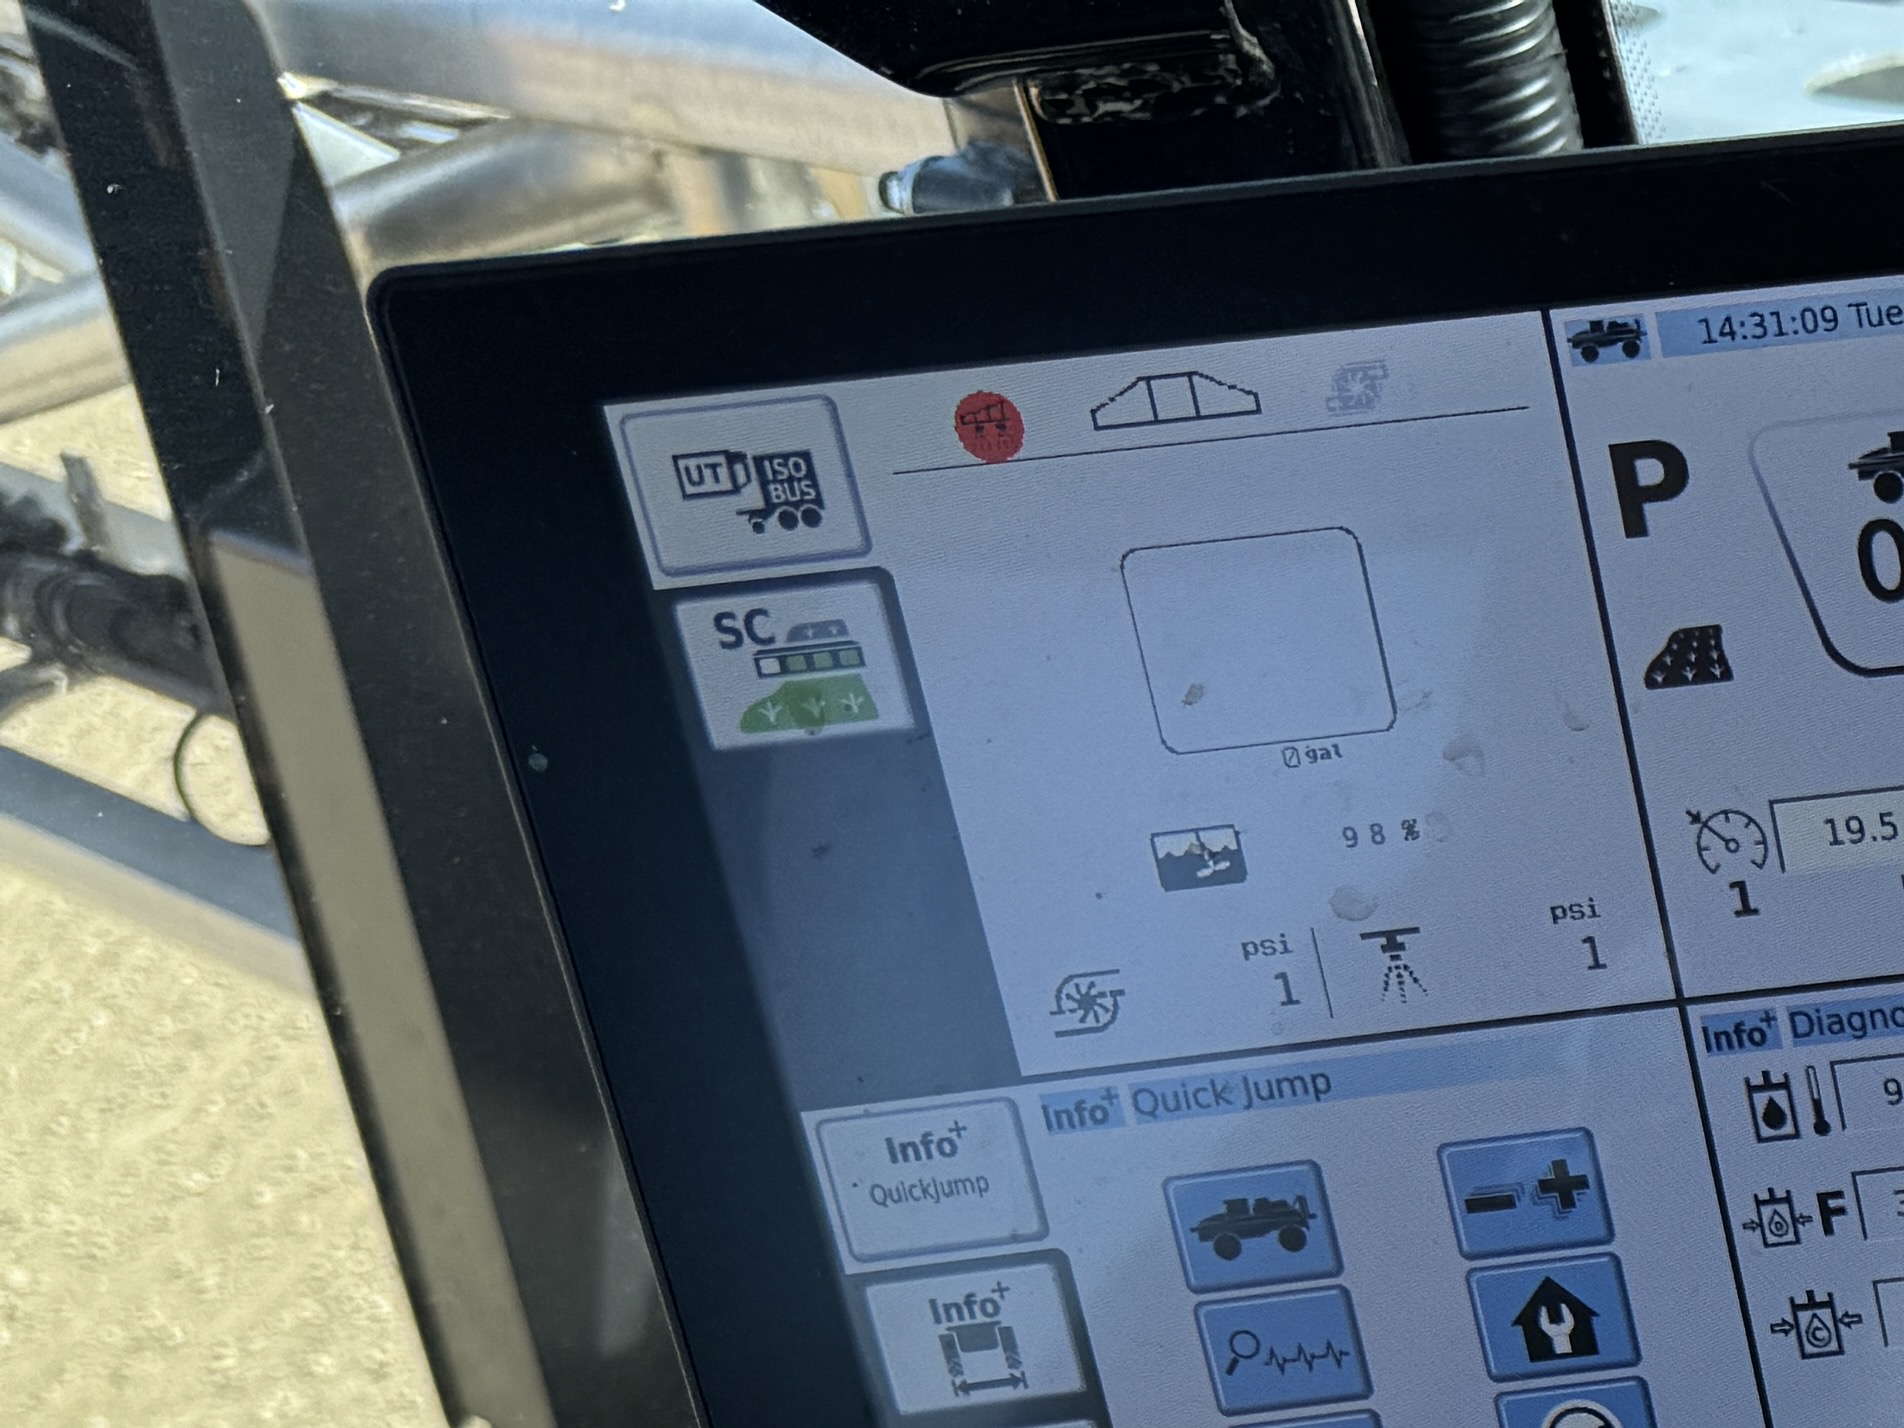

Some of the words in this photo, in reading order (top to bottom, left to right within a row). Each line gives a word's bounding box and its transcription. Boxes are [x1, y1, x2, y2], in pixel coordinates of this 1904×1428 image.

[1697, 304, 1840, 345] 14:31:09
[684, 462, 723, 487] UT
[763, 456, 807, 481] ISO
[768, 481, 816, 503] BUS
[1608, 437, 1690, 540] P
[713, 609, 776, 650] SC
[1304, 743, 1343, 765] gal
[1825, 811, 1900, 848] 19.5
[1549, 897, 1602, 925] psi
[1728, 879, 1760, 919] 1
[1240, 932, 1294, 961] psi
[1580, 935, 1608, 972] 1
[1273, 970, 1301, 1007] 1
[1131, 1077, 1232, 1121] Quick
[1242, 1067, 1334, 1110] Jump
[868, 1172, 991, 1208] QuickJump
[1815, 1190, 1848, 1238] F
